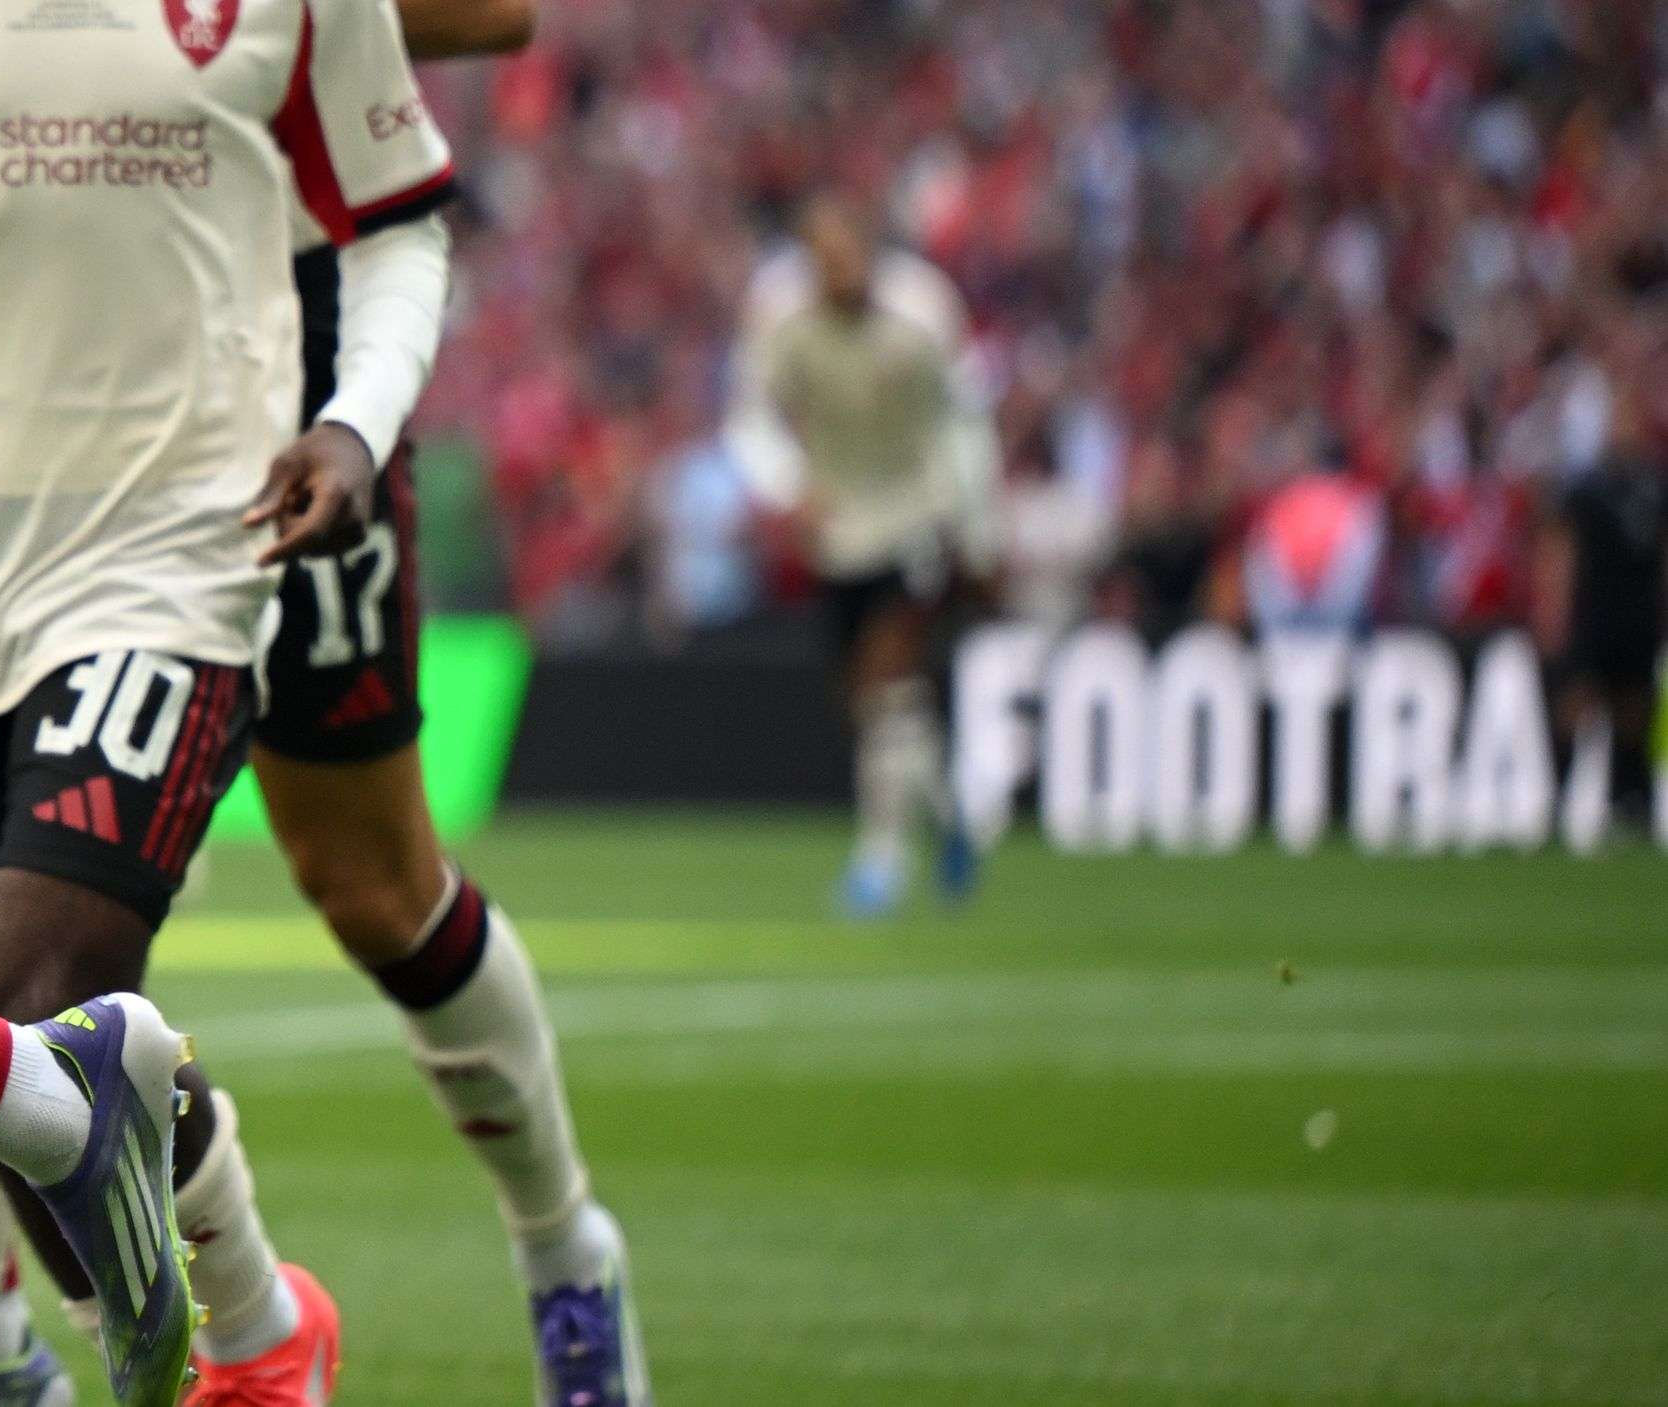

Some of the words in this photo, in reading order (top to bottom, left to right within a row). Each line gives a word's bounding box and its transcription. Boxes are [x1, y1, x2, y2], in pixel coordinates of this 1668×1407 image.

[0, 111, 210, 151] standard
[0, 150, 213, 188] chartered
[298, 520, 399, 669] 17
[33, 648, 195, 781] 30
